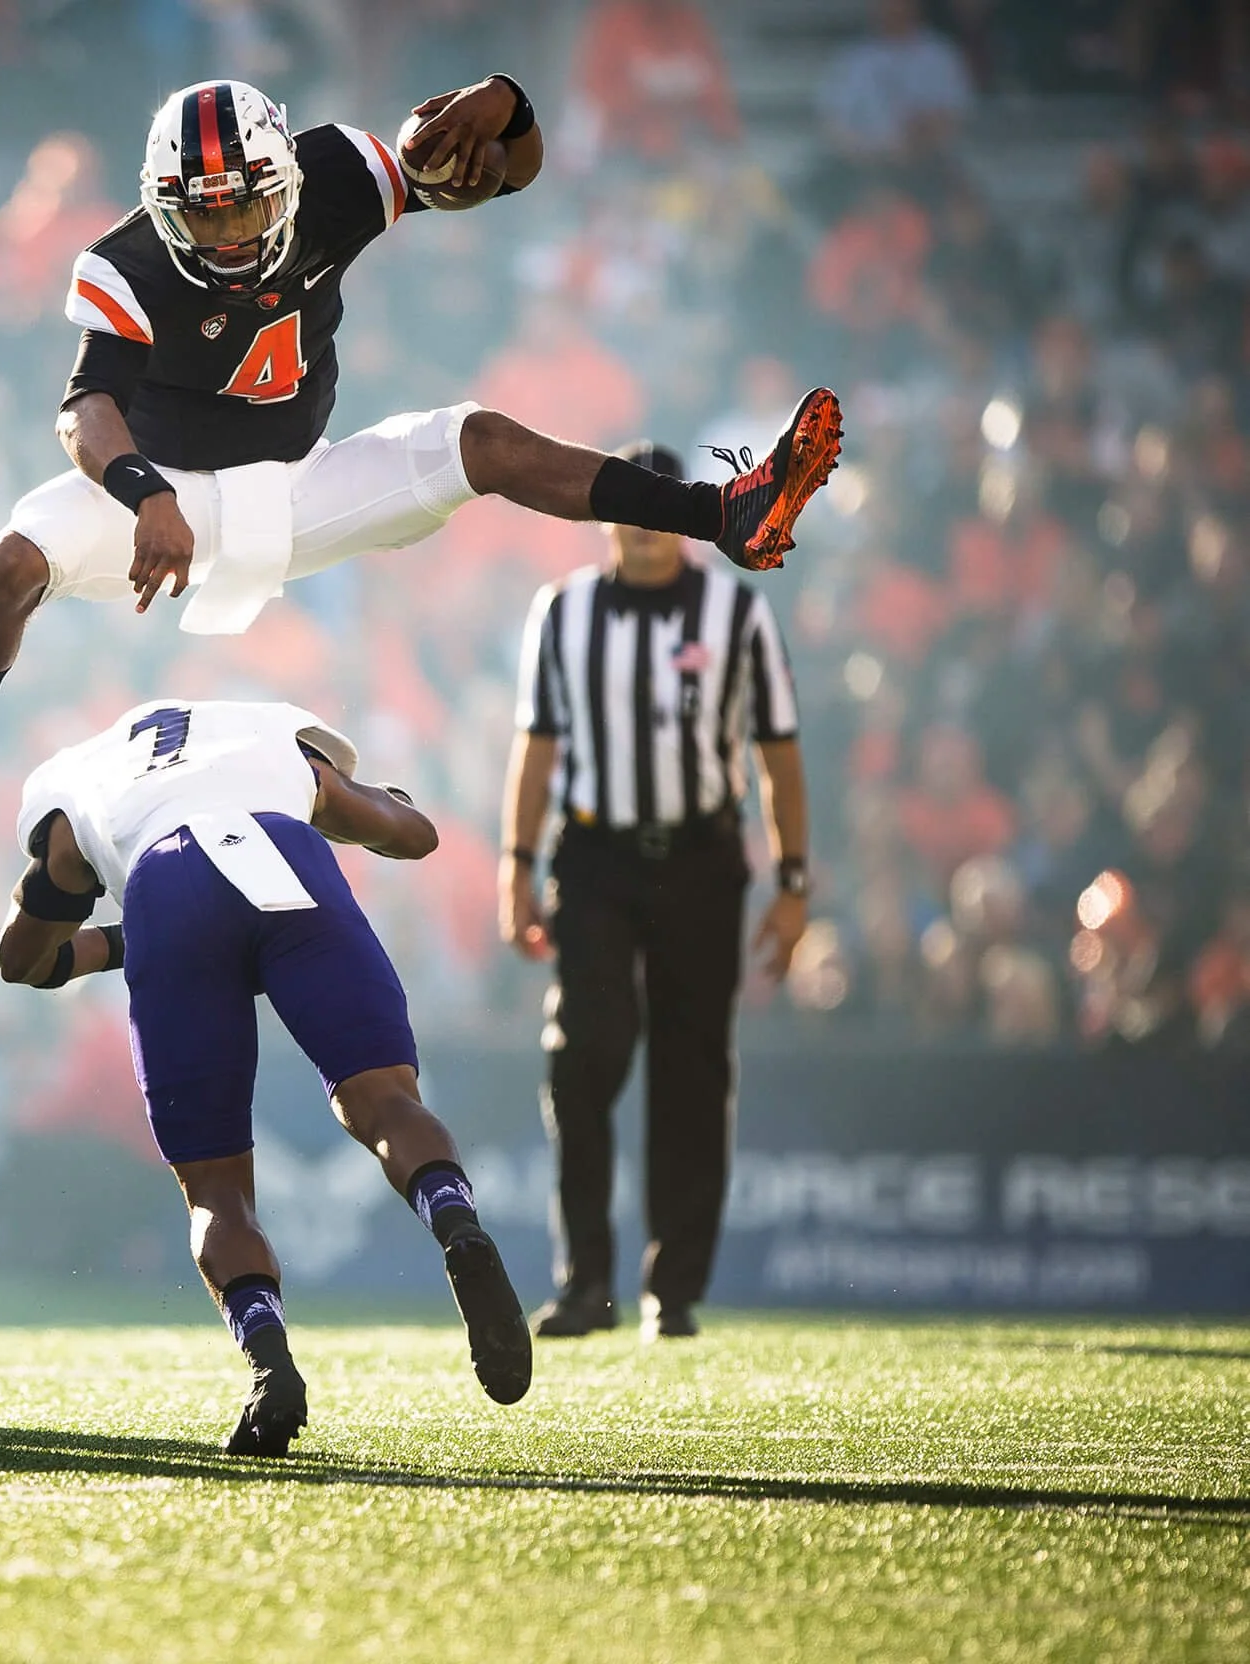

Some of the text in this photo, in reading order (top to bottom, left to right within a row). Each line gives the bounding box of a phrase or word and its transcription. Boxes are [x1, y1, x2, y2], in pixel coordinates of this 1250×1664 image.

[202, 174, 228, 189] OSU
[217, 309, 308, 404] 4
[730, 452, 775, 499] NIKE
[728, 1150, 981, 1232] ORCE
